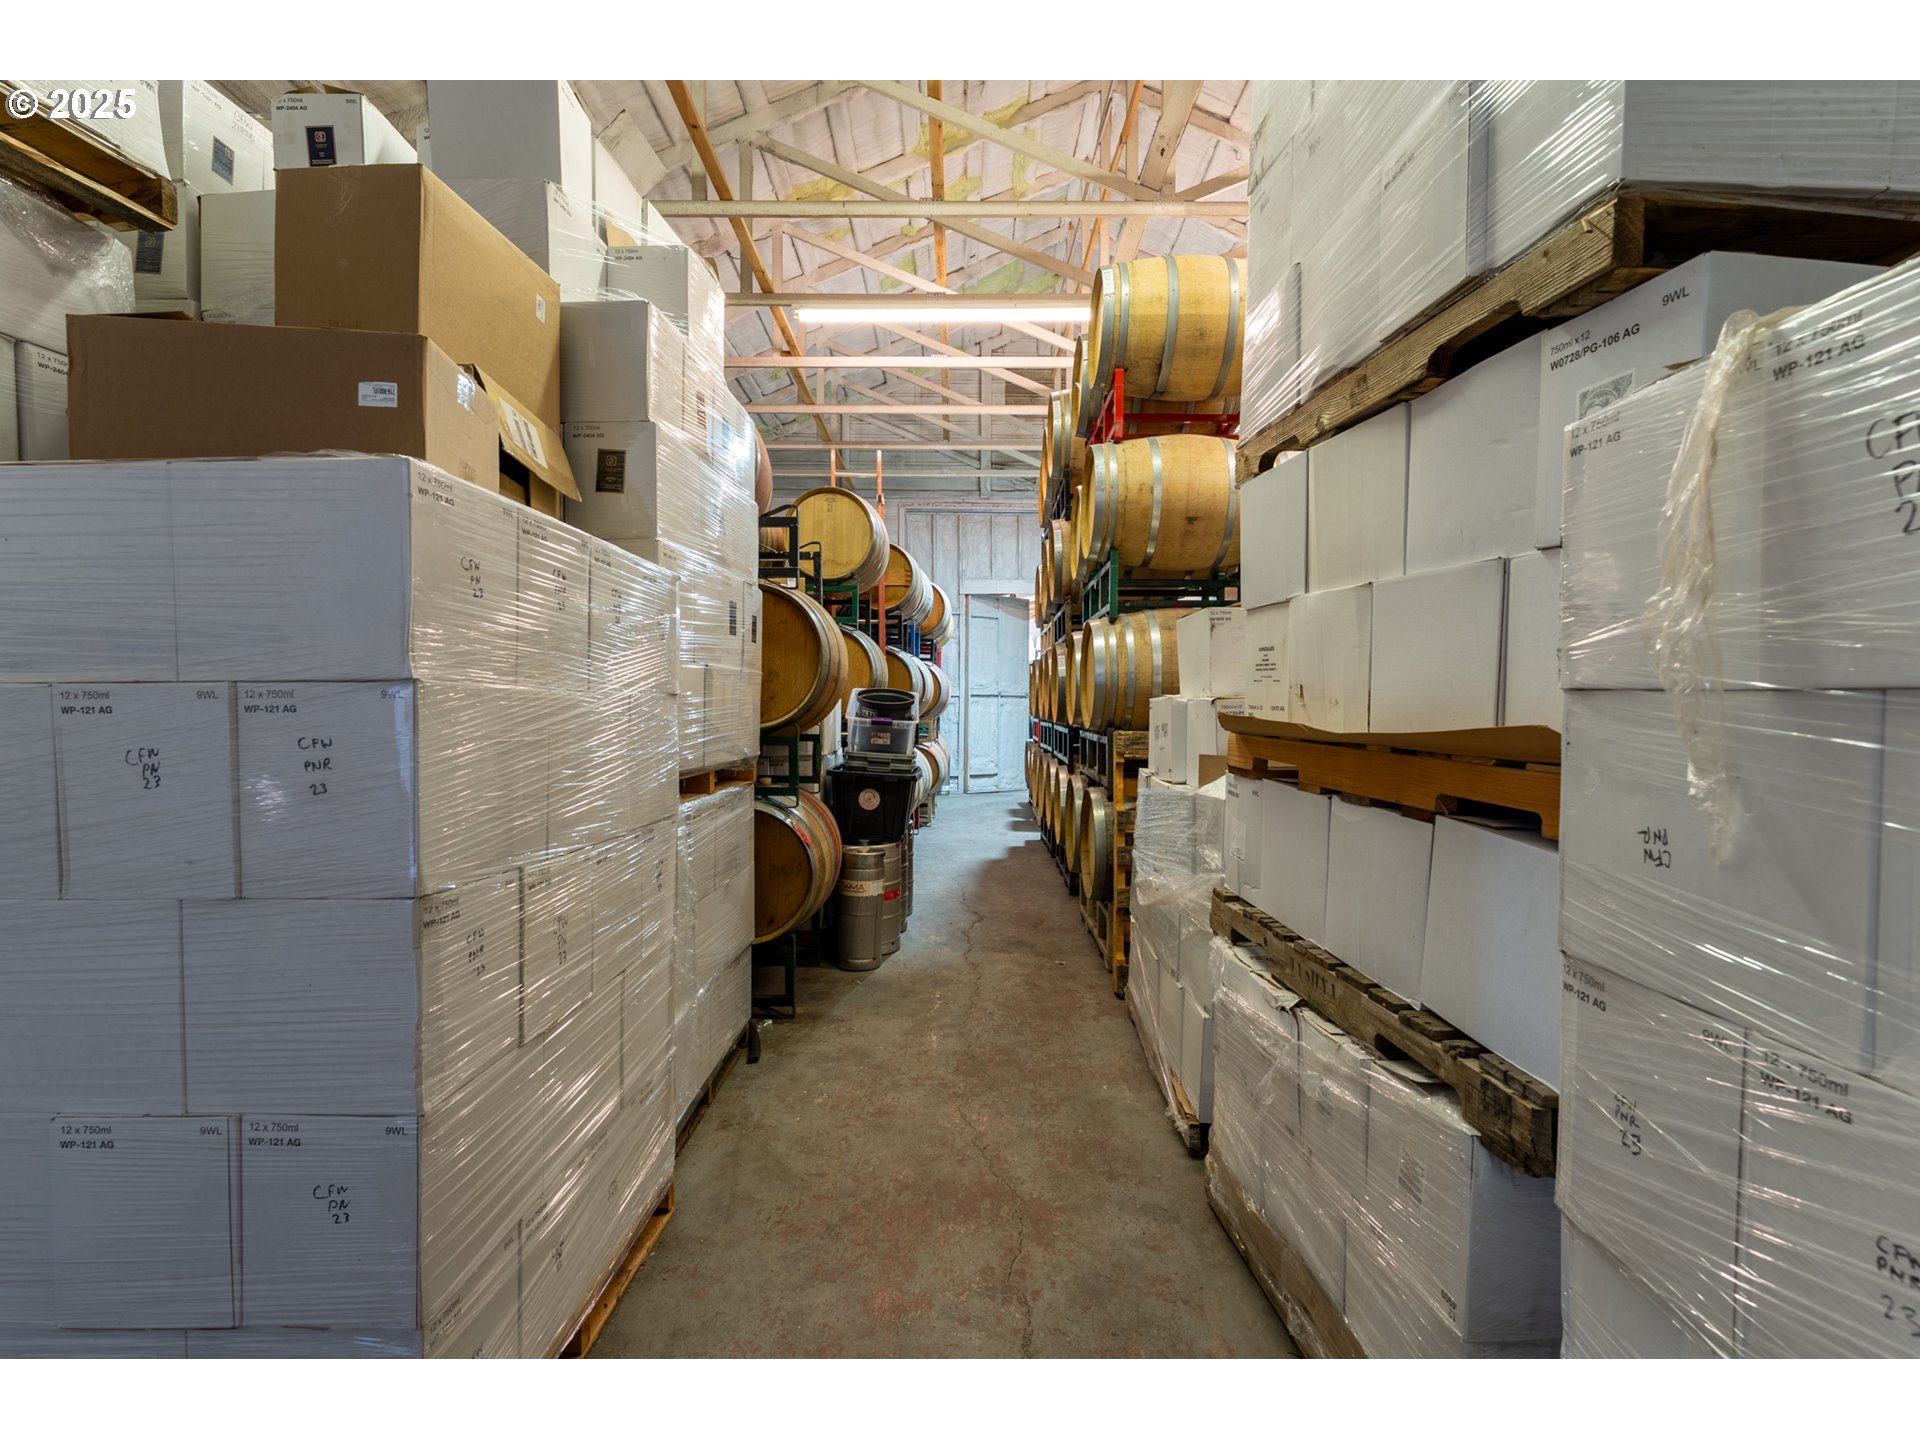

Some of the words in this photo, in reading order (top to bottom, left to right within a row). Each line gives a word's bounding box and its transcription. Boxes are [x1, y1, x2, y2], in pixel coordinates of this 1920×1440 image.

[1661, 286, 1690, 306] 9WL
[1550, 331, 1620, 371] W0728/PG-106
[1622, 323, 1641, 340] AG
[1551, 337, 1573, 356] 750ml
[37, 352, 46, 360] 12
[1772, 346, 1832, 381] WP-121
[1590, 411, 1621, 430] 750ml
[1569, 438, 1603, 458] WP-121
[1606, 430, 1621, 444] AG
[417, 472, 426, 482] 12
[417, 486, 444, 503] WP-121
[445, 496, 455, 507] AG
[473, 587, 484, 598] 23
[60, 691, 71, 700] 12
[82, 690, 110, 700] 750ml
[196, 690, 219, 700] 9WL
[244, 690, 256, 699] 12
[266, 690, 295, 699] 750ml
[381, 690, 404, 700] 9WL
[61, 706, 96, 715] WP-121
[98, 706, 113, 715] AG
[244, 705, 280, 713] WP-121
[282, 704, 297, 713] AG
[297, 736, 333, 750] CFW
[142, 762, 161, 777] PN
[303, 757, 333, 772] PNR
[142, 775, 161, 789] 23
[309, 783, 328, 796] 23
[422, 914, 450, 929] WP-121
[1563, 963, 1570, 976] 12
[1578, 970, 1605, 992] 750ml
[1562, 981, 1590, 1004] WP-121
[1592, 997, 1606, 1012] AG
[1763, 1051, 1780, 1068] 12
[1798, 1063, 1849, 1097] 750ml
[1759, 1070, 1821, 1110] WP-121
[1825, 1102, 1852, 1124] AG
[1613, 1105, 1640, 1129] PNR
[60, 1125, 72, 1135] 12
[83, 1125, 112, 1135] 750ml
[200, 1126, 222, 1136] 9WL
[249, 1122, 260, 1132] 12
[271, 1122, 299, 1132] 750ml
[385, 1126, 408, 1136] 9WL
[60, 1140, 97, 1149] WP-121
[100, 1140, 115, 1149] AG
[248, 1138, 284, 1147] WP-121
[286, 1138, 301, 1147] AG
[328, 1199, 351, 1213] PN
[332, 1212, 350, 1224] 23
